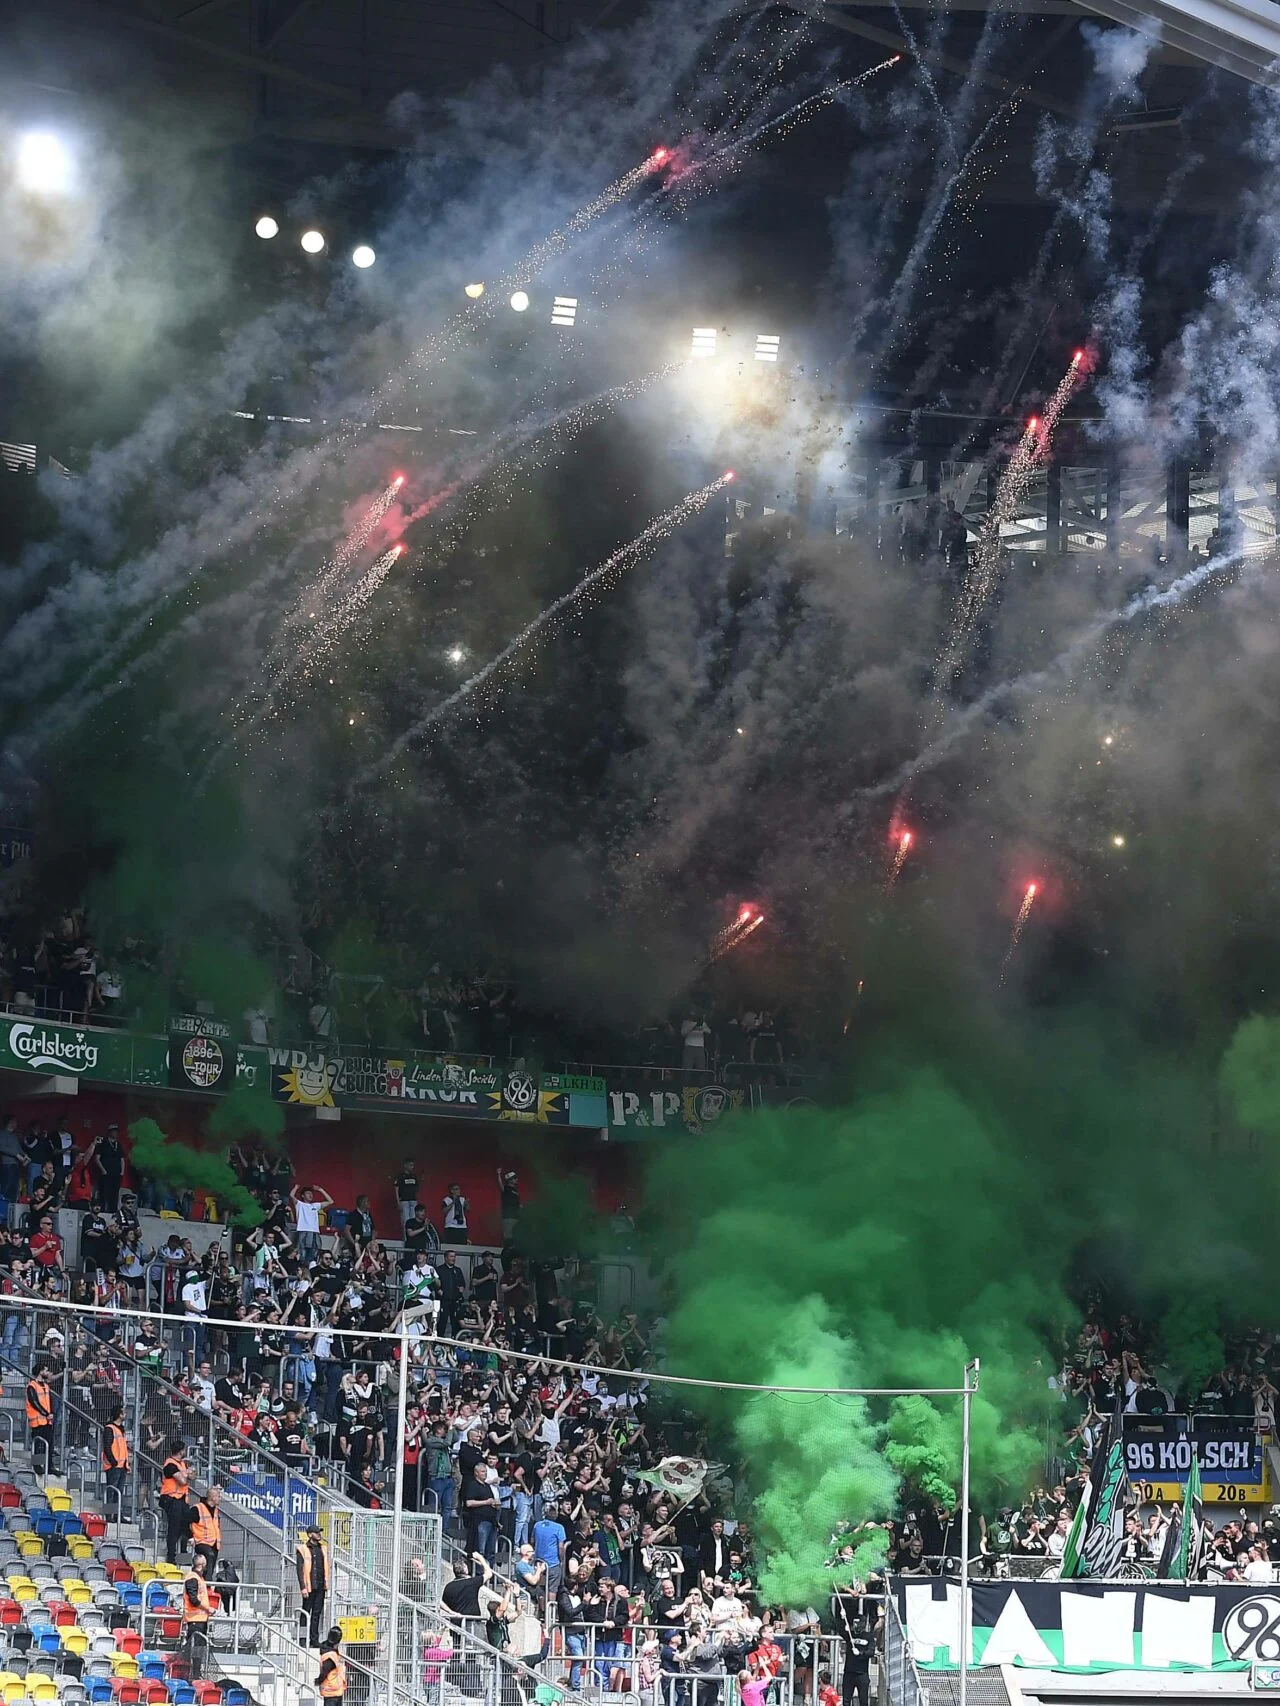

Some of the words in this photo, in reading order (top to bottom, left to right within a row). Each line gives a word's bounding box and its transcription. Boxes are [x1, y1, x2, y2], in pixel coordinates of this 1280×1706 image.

[9, 1023, 98, 1071] Carlsberg
[188, 1045, 214, 1059] 1896
[194, 1061, 221, 1075] TOUR
[267, 1047, 325, 1073] WDJ
[410, 1064, 442, 1084] Linden
[465, 1068, 497, 1089] Society
[1127, 1442, 1154, 1469] 96
[1159, 1432, 1249, 1469] KÖLSCH
[354, 1628, 365, 1640] 18
